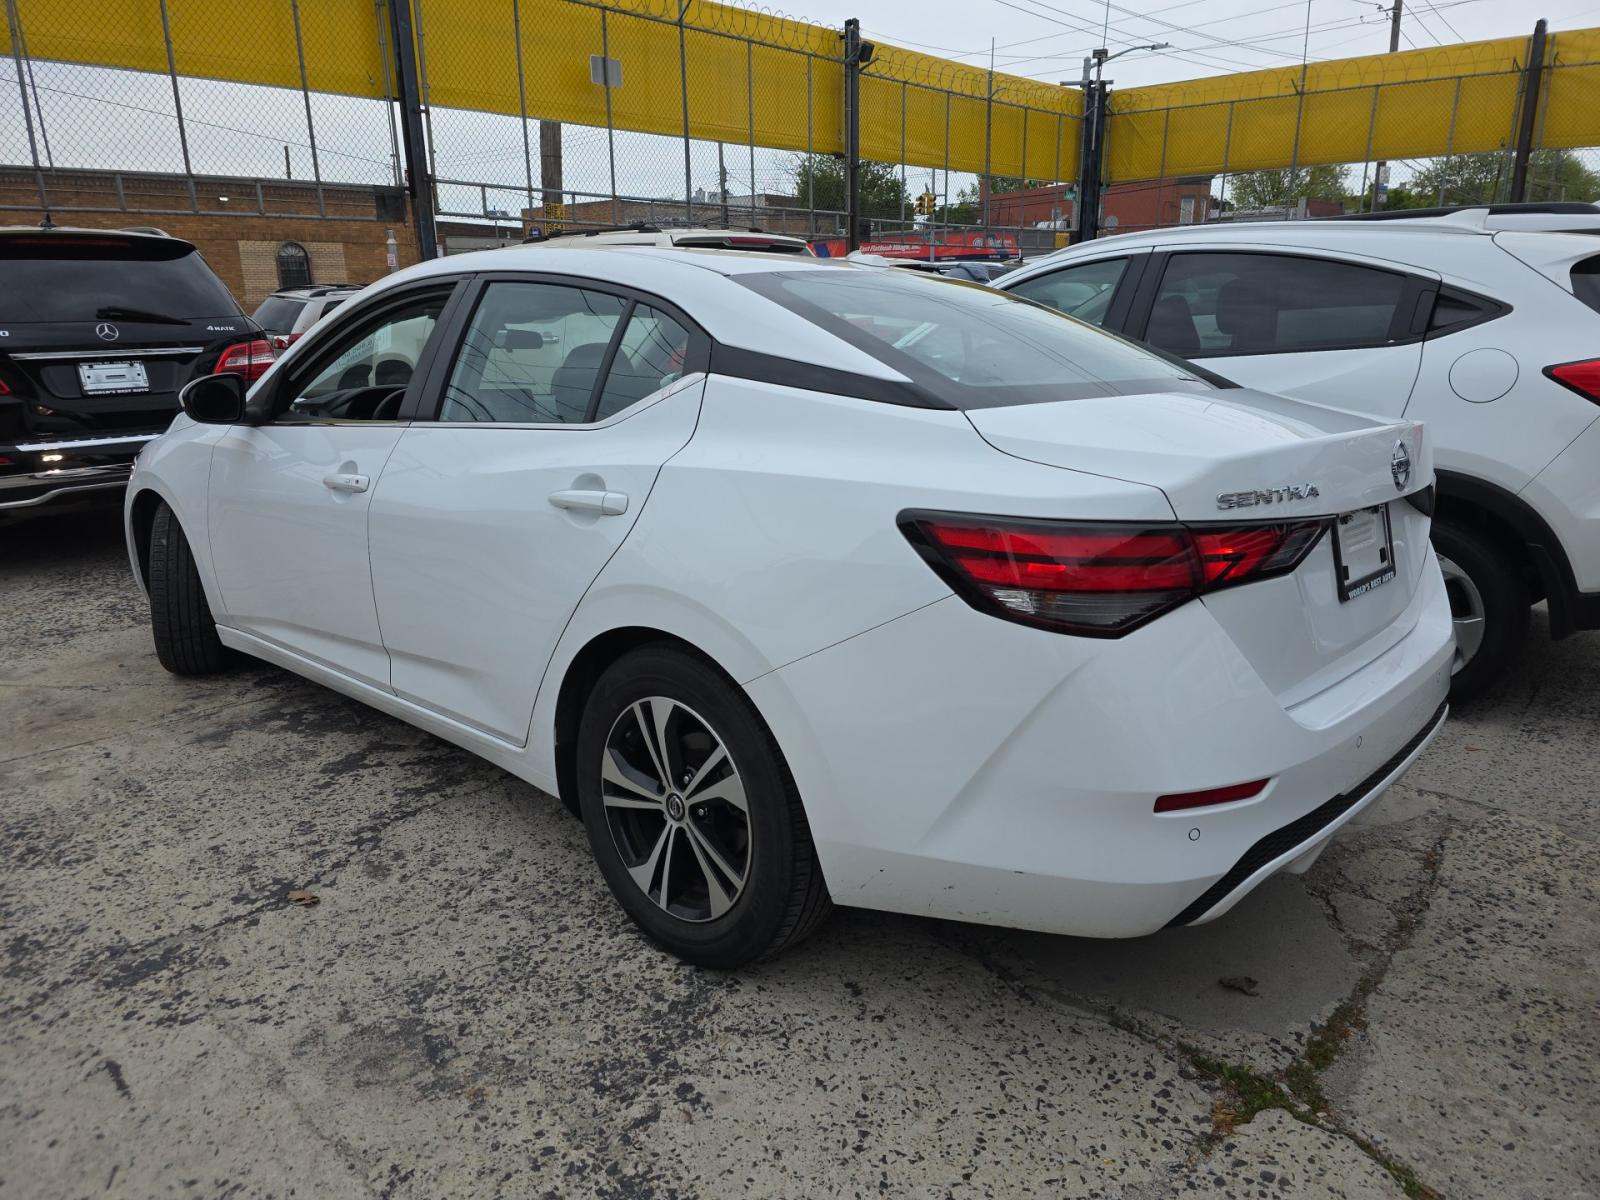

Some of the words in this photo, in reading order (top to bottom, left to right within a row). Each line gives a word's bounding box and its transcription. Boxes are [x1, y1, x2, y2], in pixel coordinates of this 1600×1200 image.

[1216, 482, 1320, 511] SENTRA
[1370, 576, 1382, 589] BEST
[1382, 571, 1395, 583] AUTO
